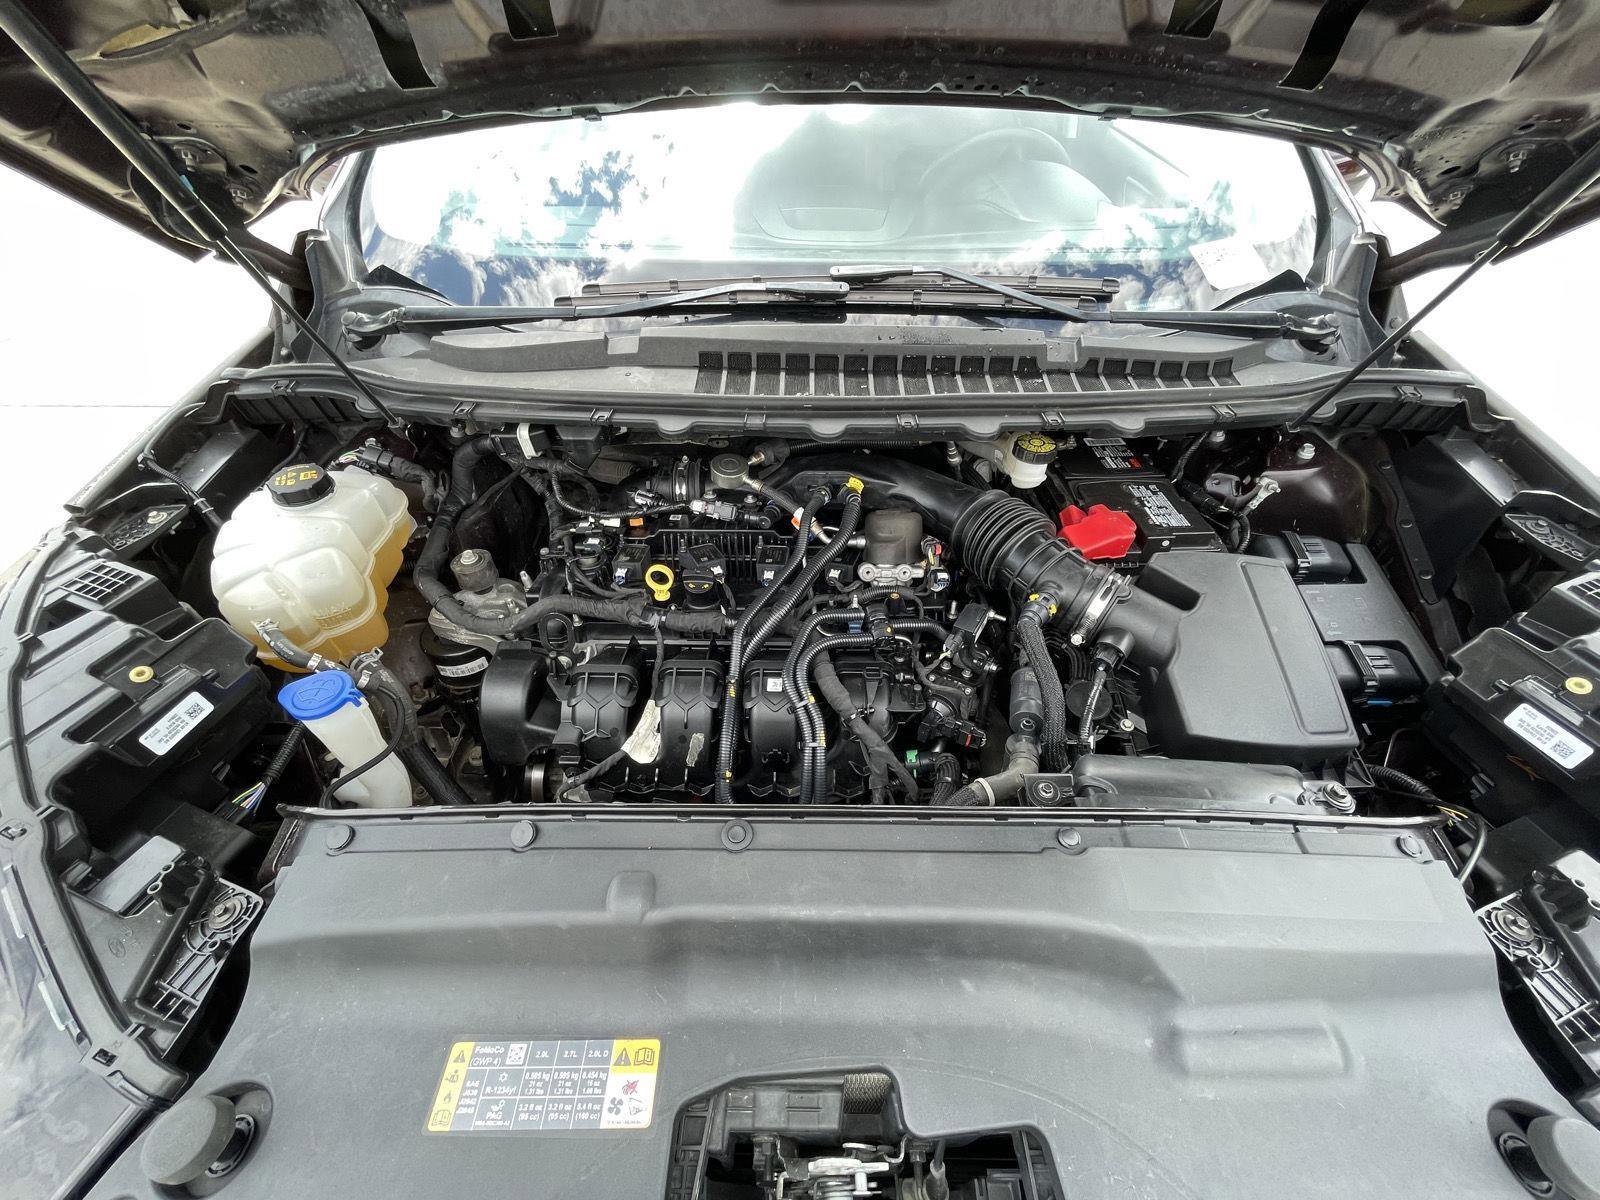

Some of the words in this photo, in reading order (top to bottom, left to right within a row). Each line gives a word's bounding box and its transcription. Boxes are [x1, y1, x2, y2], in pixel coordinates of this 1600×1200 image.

[475, 1046, 505, 1055] FoMoCo
[535, 1049, 550, 1058] 2.0L
[563, 1049, 578, 1058] 2.7L
[469, 1056, 491, 1067] (GWP
[542, 1072, 551, 1082] kg
[570, 1071, 579, 1082] kg
[598, 1071, 607, 1081] kg
